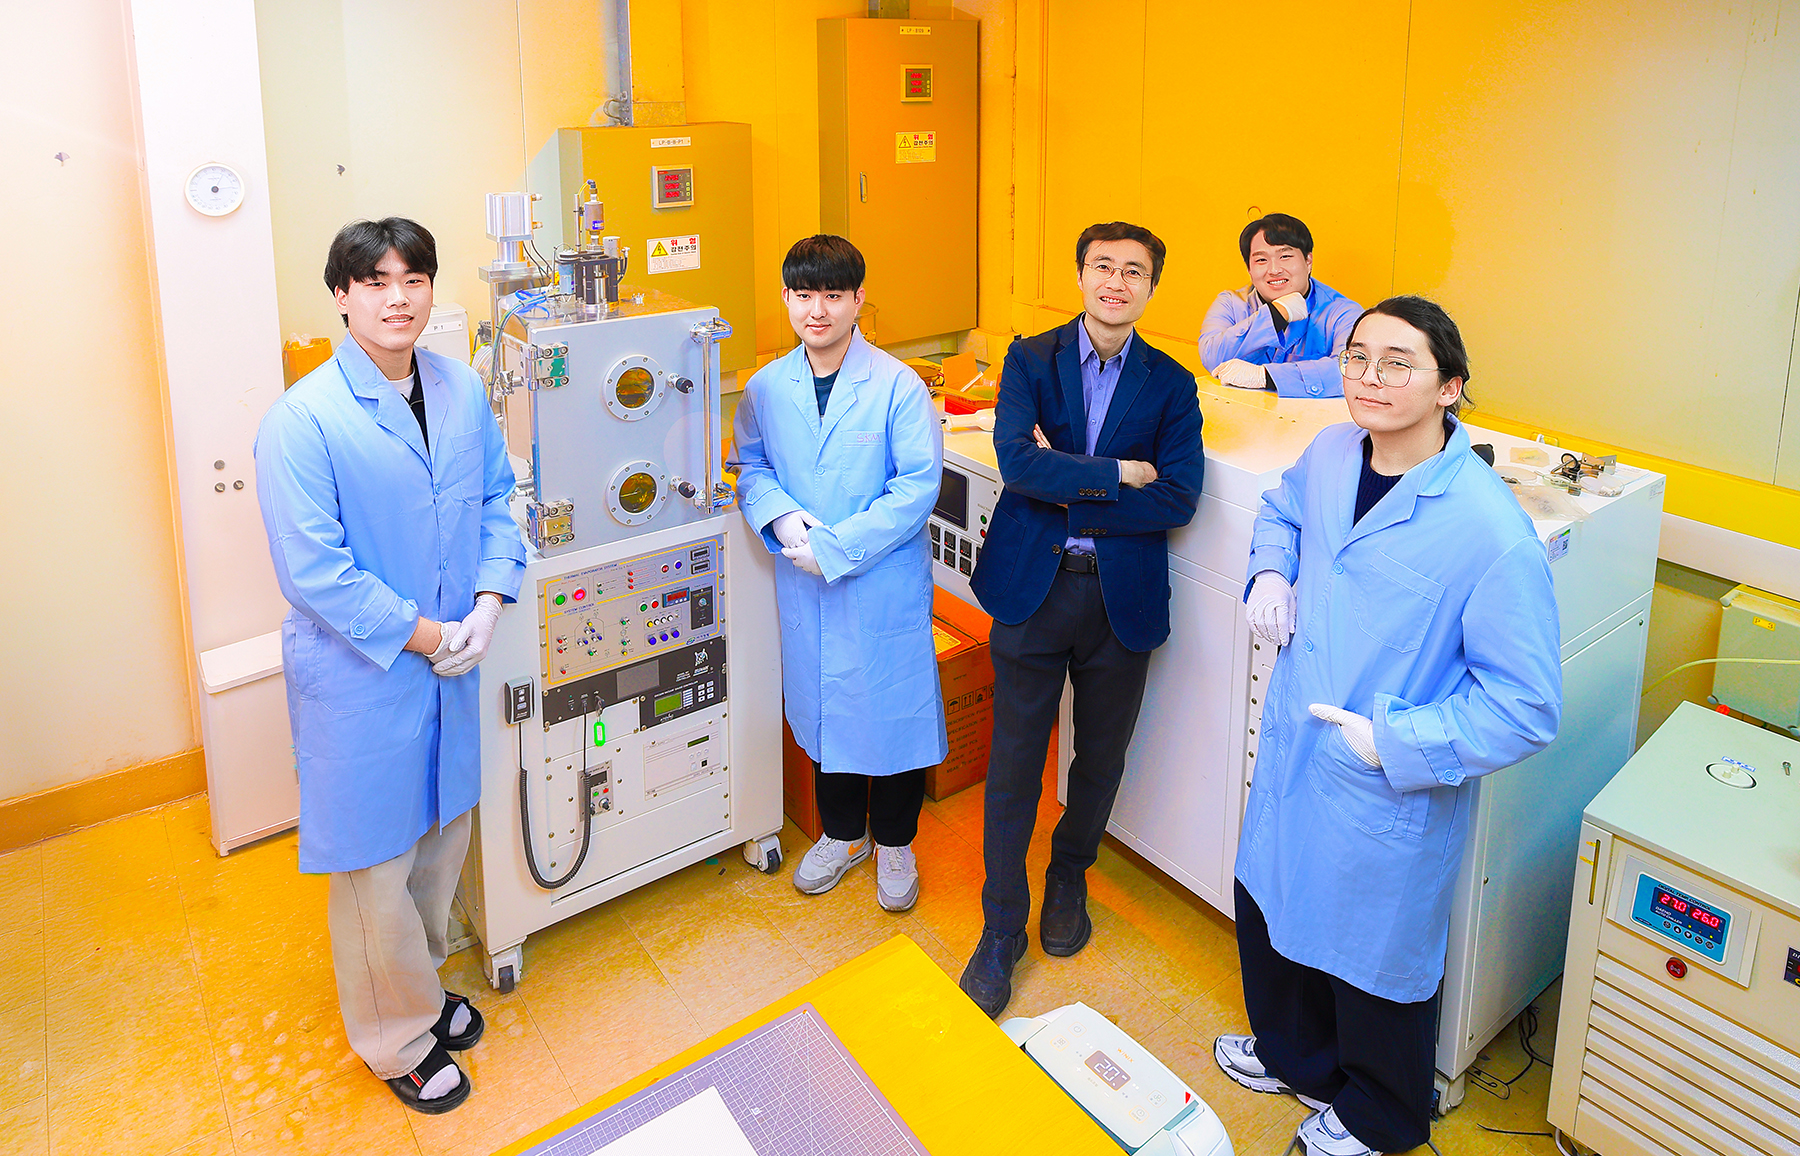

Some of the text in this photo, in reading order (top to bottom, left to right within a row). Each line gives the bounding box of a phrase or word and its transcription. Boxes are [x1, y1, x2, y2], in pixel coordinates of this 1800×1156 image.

[856, 432, 882, 443] SKM
[1692, 908, 1720, 928] 26.0
[1117, 1047, 1134, 1063] WINIX
